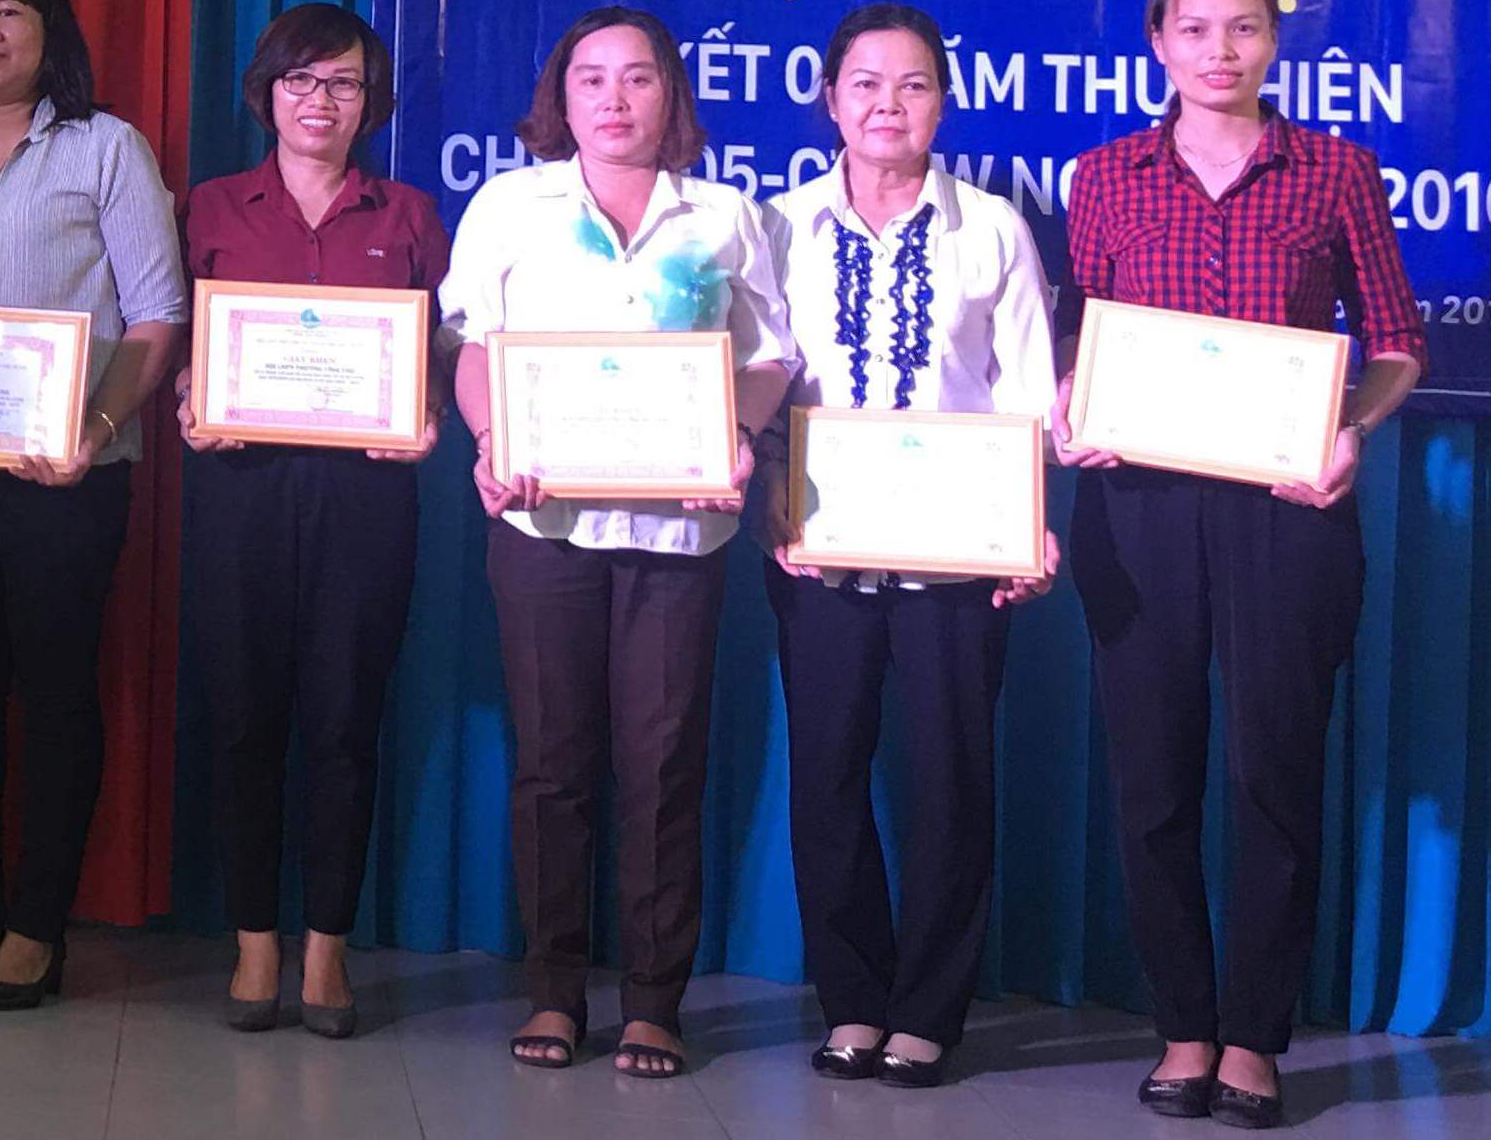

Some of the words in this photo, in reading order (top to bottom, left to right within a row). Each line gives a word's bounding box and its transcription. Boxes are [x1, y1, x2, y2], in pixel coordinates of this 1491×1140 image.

[679, 21, 771, 102] ẾT
[941, 34, 1025, 111] ĂM
[441, 133, 543, 192] CH
[1378, 166, 1491, 232] 201
[1441, 295, 1491, 324] 20
